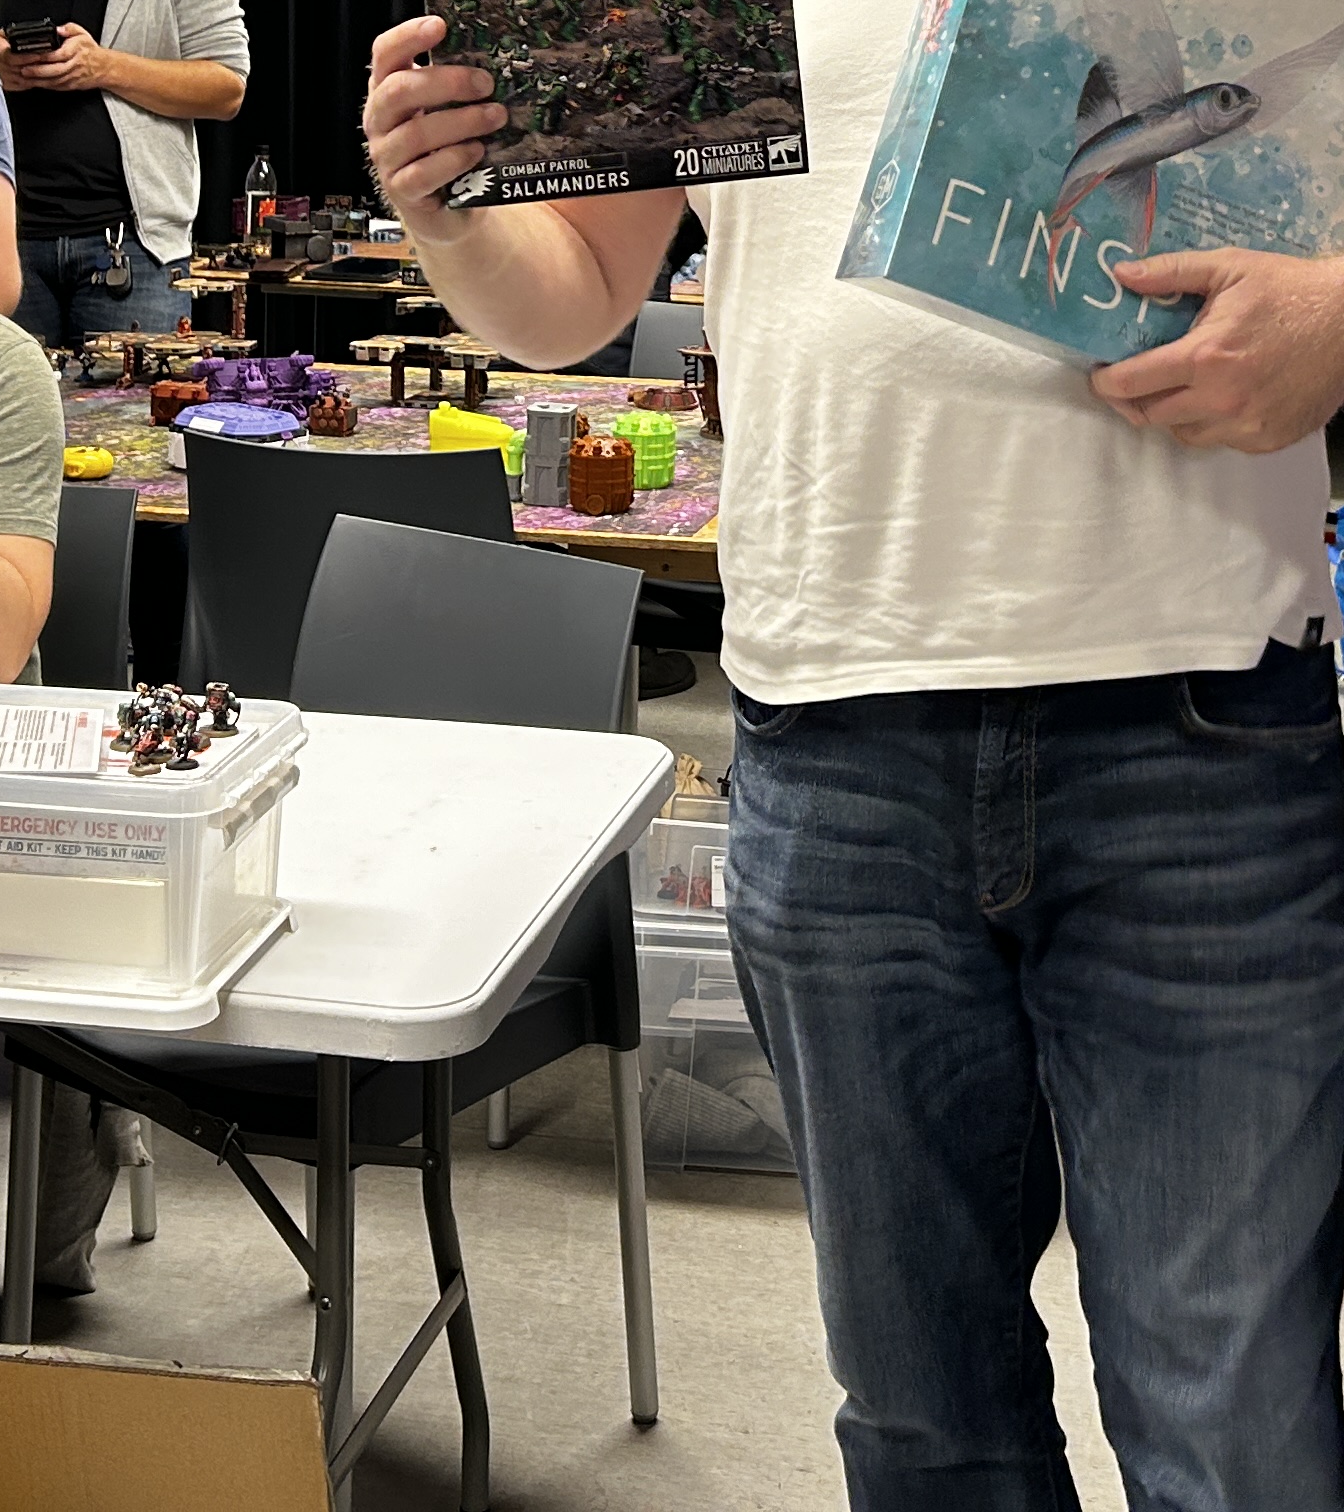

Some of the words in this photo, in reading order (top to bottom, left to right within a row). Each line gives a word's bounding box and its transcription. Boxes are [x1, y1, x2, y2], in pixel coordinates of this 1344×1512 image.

[502, 161, 545, 178] COMBAT
[549, 158, 591, 173] PATROL
[675, 147, 699, 177] 20
[701, 140, 763, 157] CITADEL
[702, 153, 766, 176] MINIATURES
[501, 170, 631, 199] SALAMANDERS
[84, 820, 118, 839] USE
[124, 823, 167, 842] ONLY
[6, 840, 24, 852] AID
[26, 841, 43, 853] KIT
[54, 843, 82, 855] KEEP
[85, 845, 108, 857] THIS
[111, 847, 127, 859] KIT
[130, 848, 167, 861] HANDY
